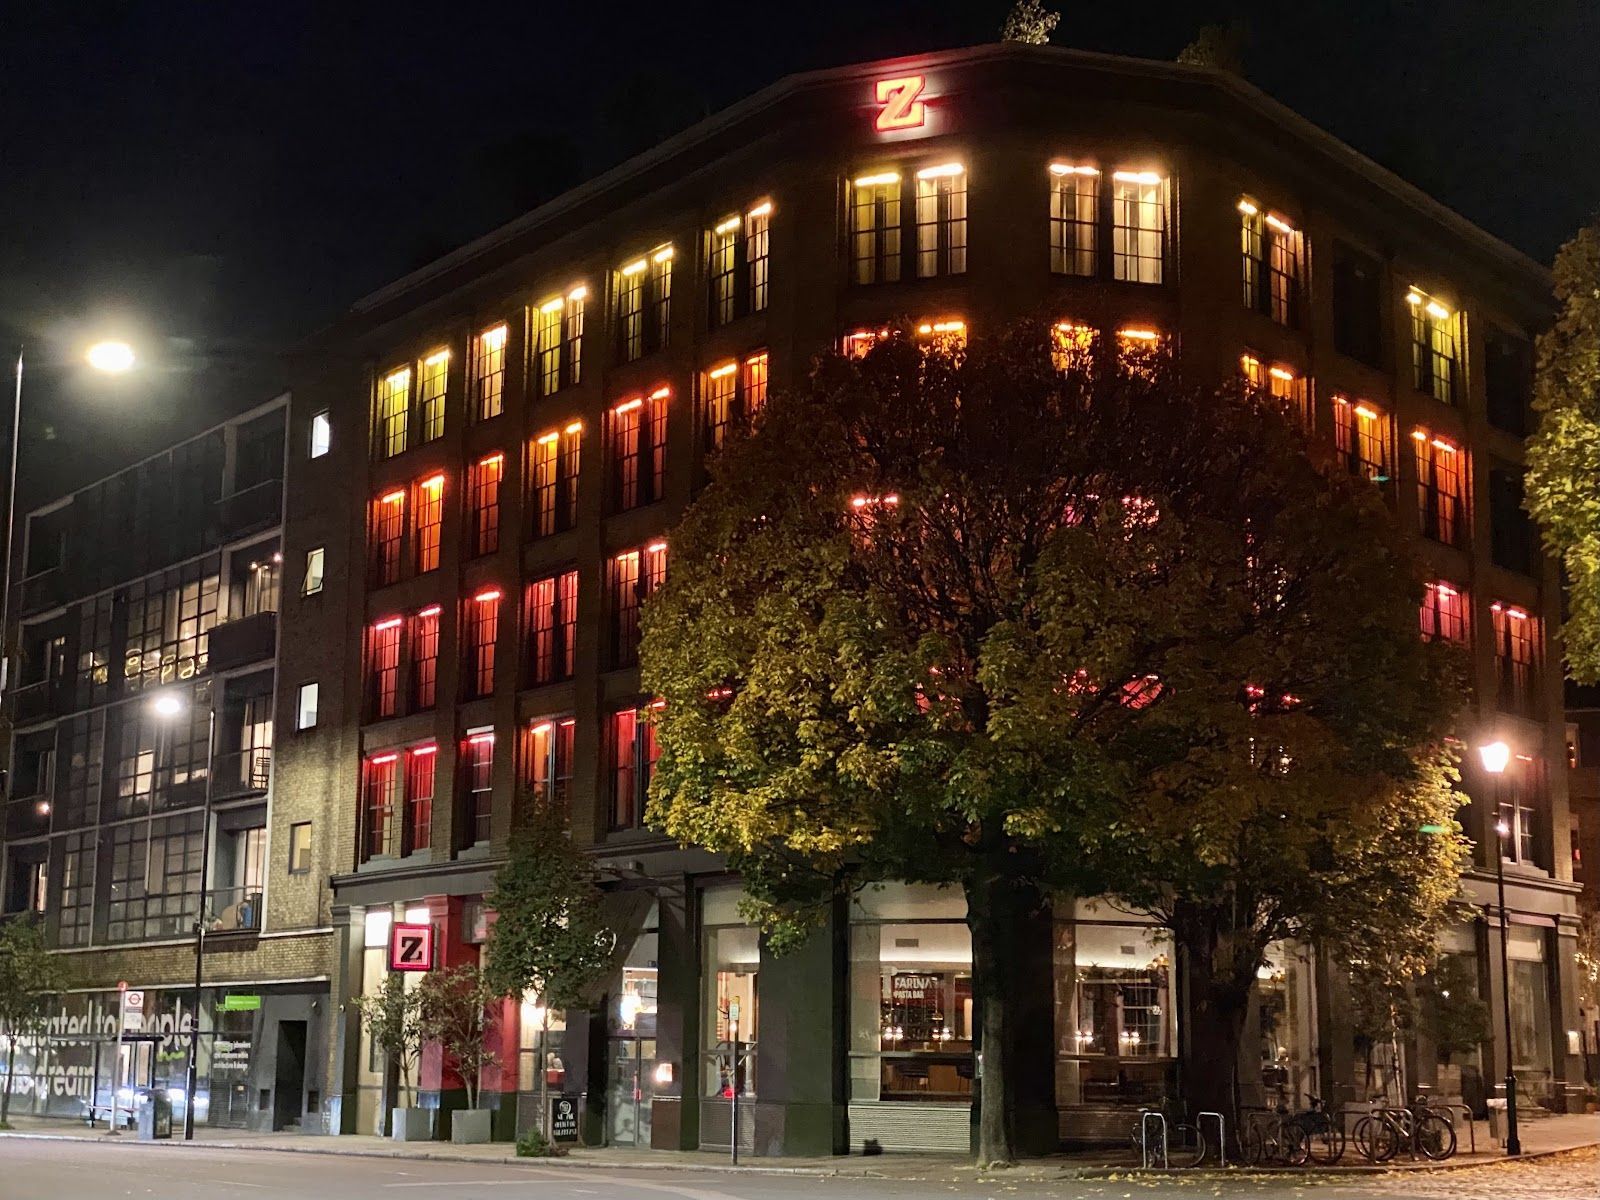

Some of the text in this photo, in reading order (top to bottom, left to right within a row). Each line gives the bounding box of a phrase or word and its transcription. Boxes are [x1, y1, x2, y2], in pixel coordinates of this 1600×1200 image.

[875, 75, 925, 132] Z
[401, 937, 423, 963] Z
[912, 990, 924, 999] BAR
[121, 996, 193, 1051] eople
